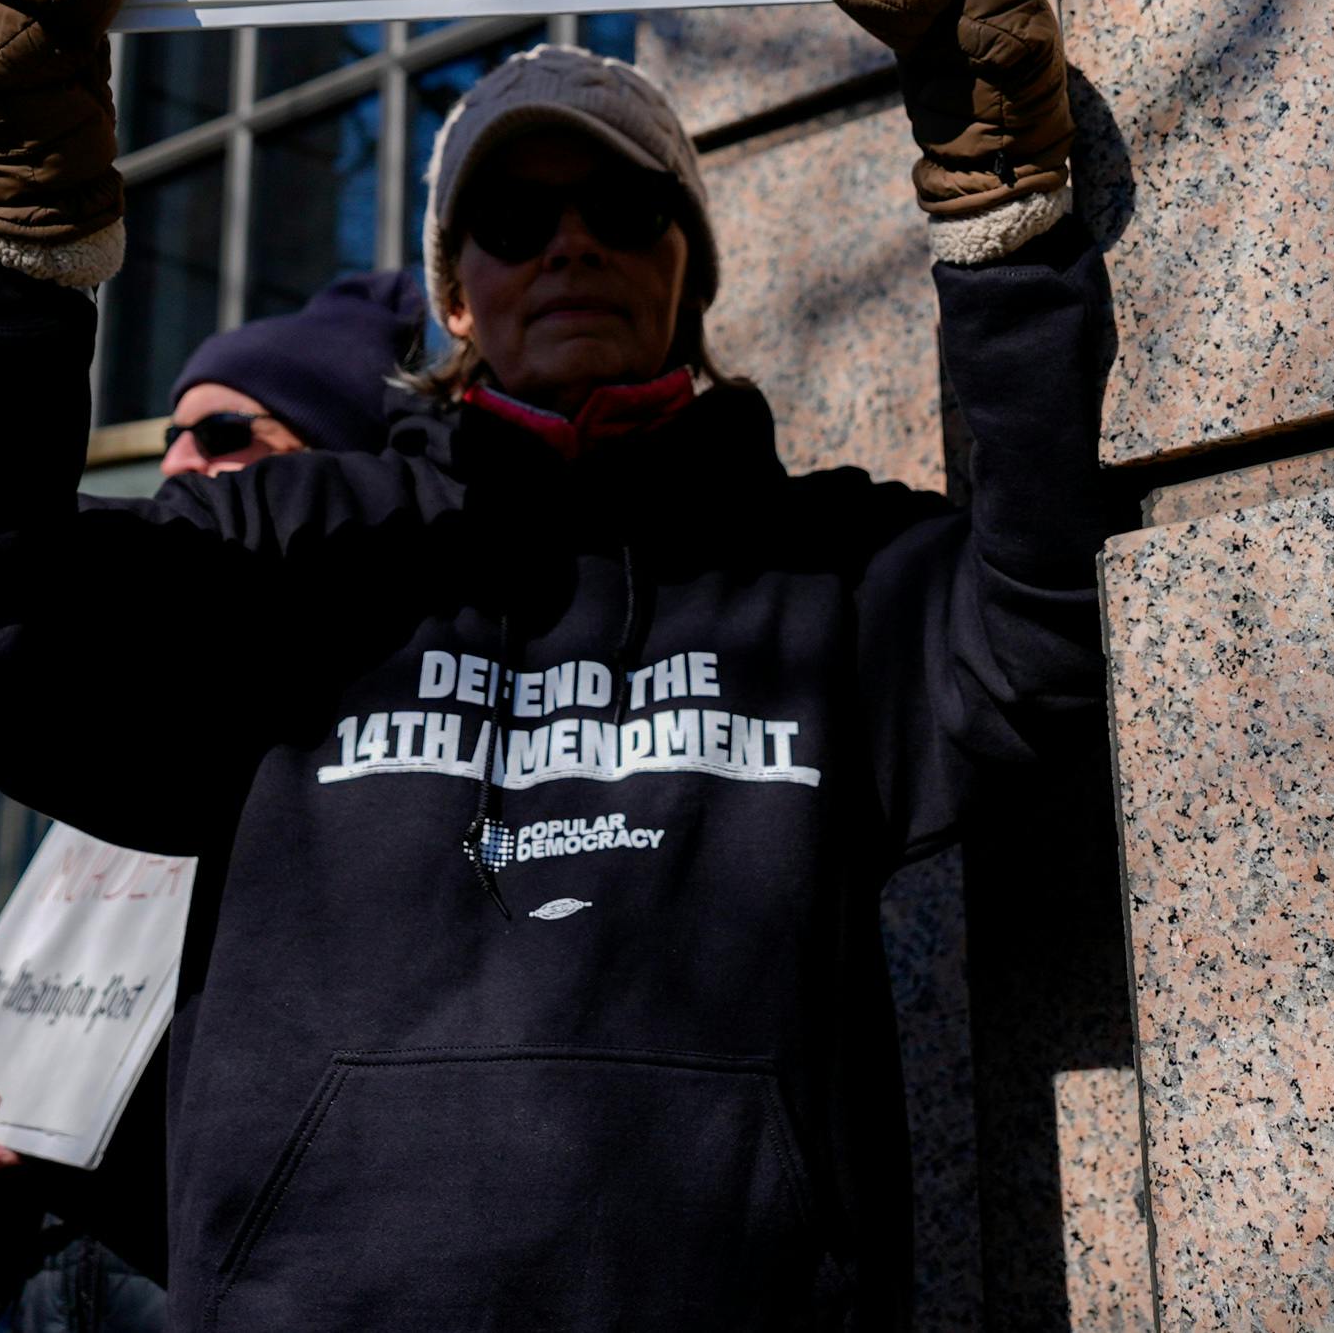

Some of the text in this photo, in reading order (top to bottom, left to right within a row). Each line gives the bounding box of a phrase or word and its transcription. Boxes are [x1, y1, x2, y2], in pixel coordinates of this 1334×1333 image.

[418, 650, 722, 717] DEFEND THE
[336, 709, 800, 782] 14TH AMENDMENT
[516, 828, 665, 863] DEMOCRACY
[517, 813, 626, 846] POPULAR
